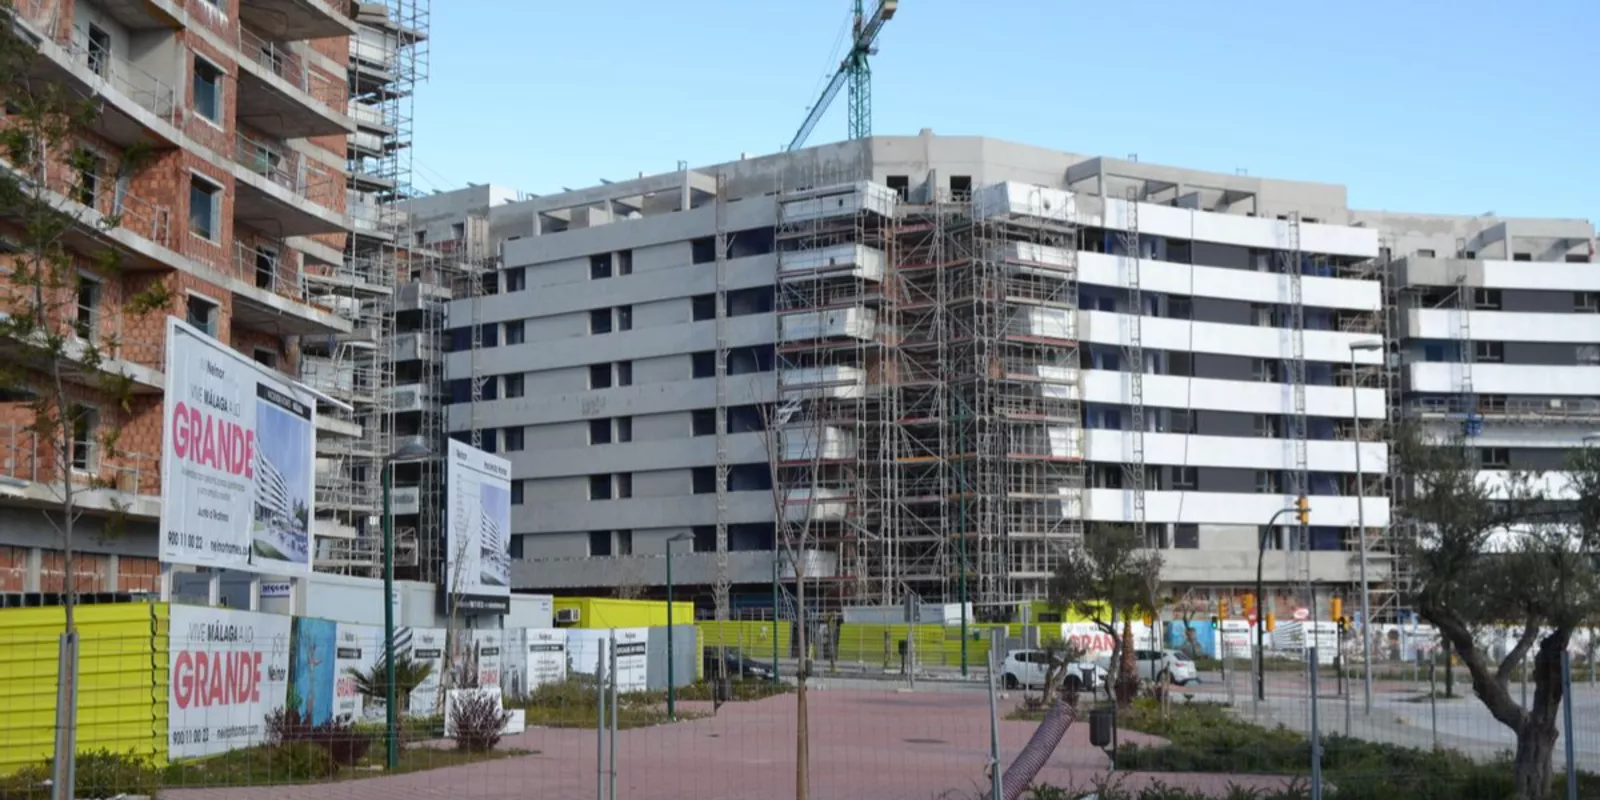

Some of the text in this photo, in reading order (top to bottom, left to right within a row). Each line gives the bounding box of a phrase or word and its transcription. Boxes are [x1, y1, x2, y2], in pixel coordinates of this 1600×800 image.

[204, 388, 228, 413] MÁLAGA
[172, 400, 254, 480] GRANDE
[168, 529, 179, 547] 900
[207, 619, 238, 642] MÁLAGA
[173, 649, 262, 709] GRANDE
[173, 730, 184, 746] 900
